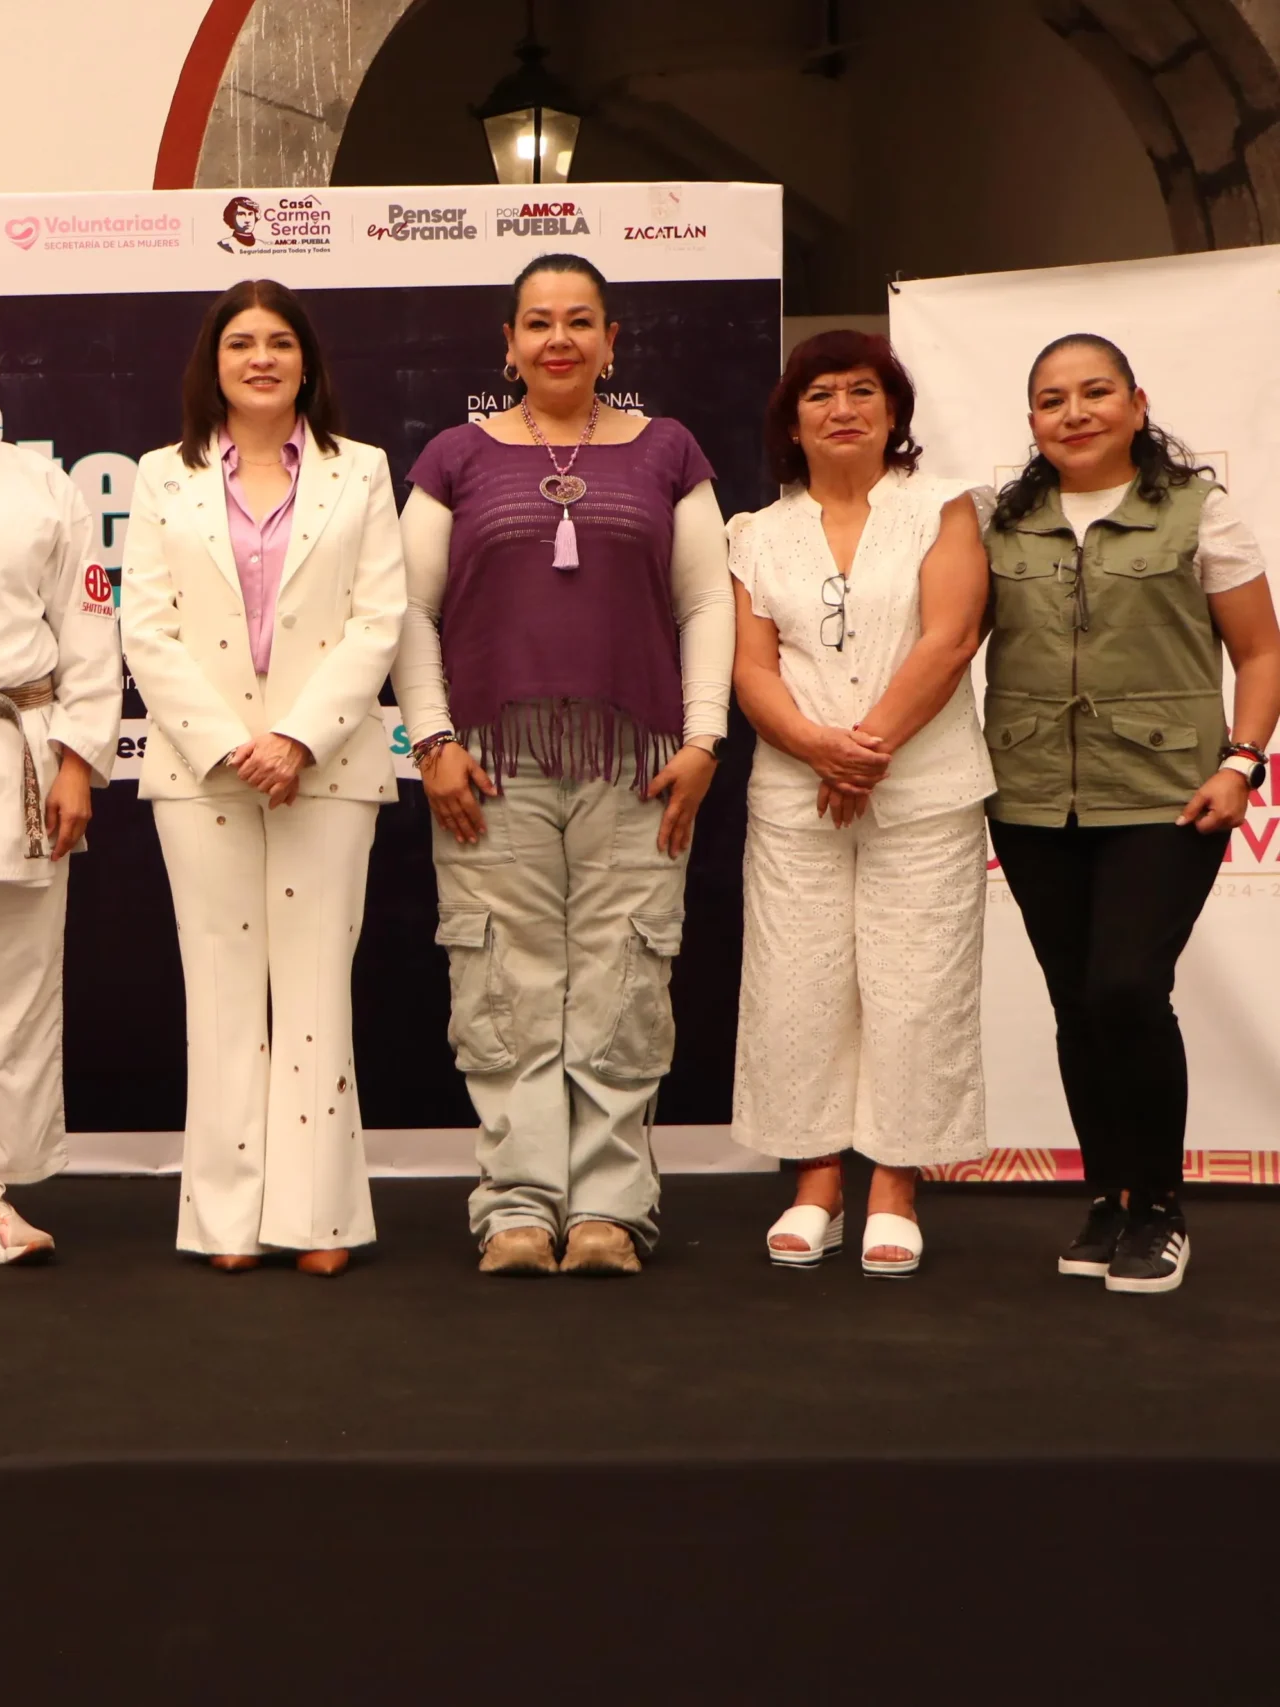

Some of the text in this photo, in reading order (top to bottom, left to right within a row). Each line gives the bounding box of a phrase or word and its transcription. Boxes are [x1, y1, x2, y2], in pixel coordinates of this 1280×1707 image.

[279, 199, 313, 209] Casa
[496, 208, 520, 218] POR
[519, 202, 575, 217] AMOR
[263, 208, 331, 222] Carmen
[388, 204, 467, 224] Pensar
[44, 214, 182, 234] Voluntariado
[391, 221, 478, 242] Grande
[496, 217, 591, 237] PUEBLA
[624, 223, 707, 240] ZACATLÁN
[44, 239, 180, 250] SECRETARÍA DE LAS MUJERES
[467, 392, 498, 410] DÍA
